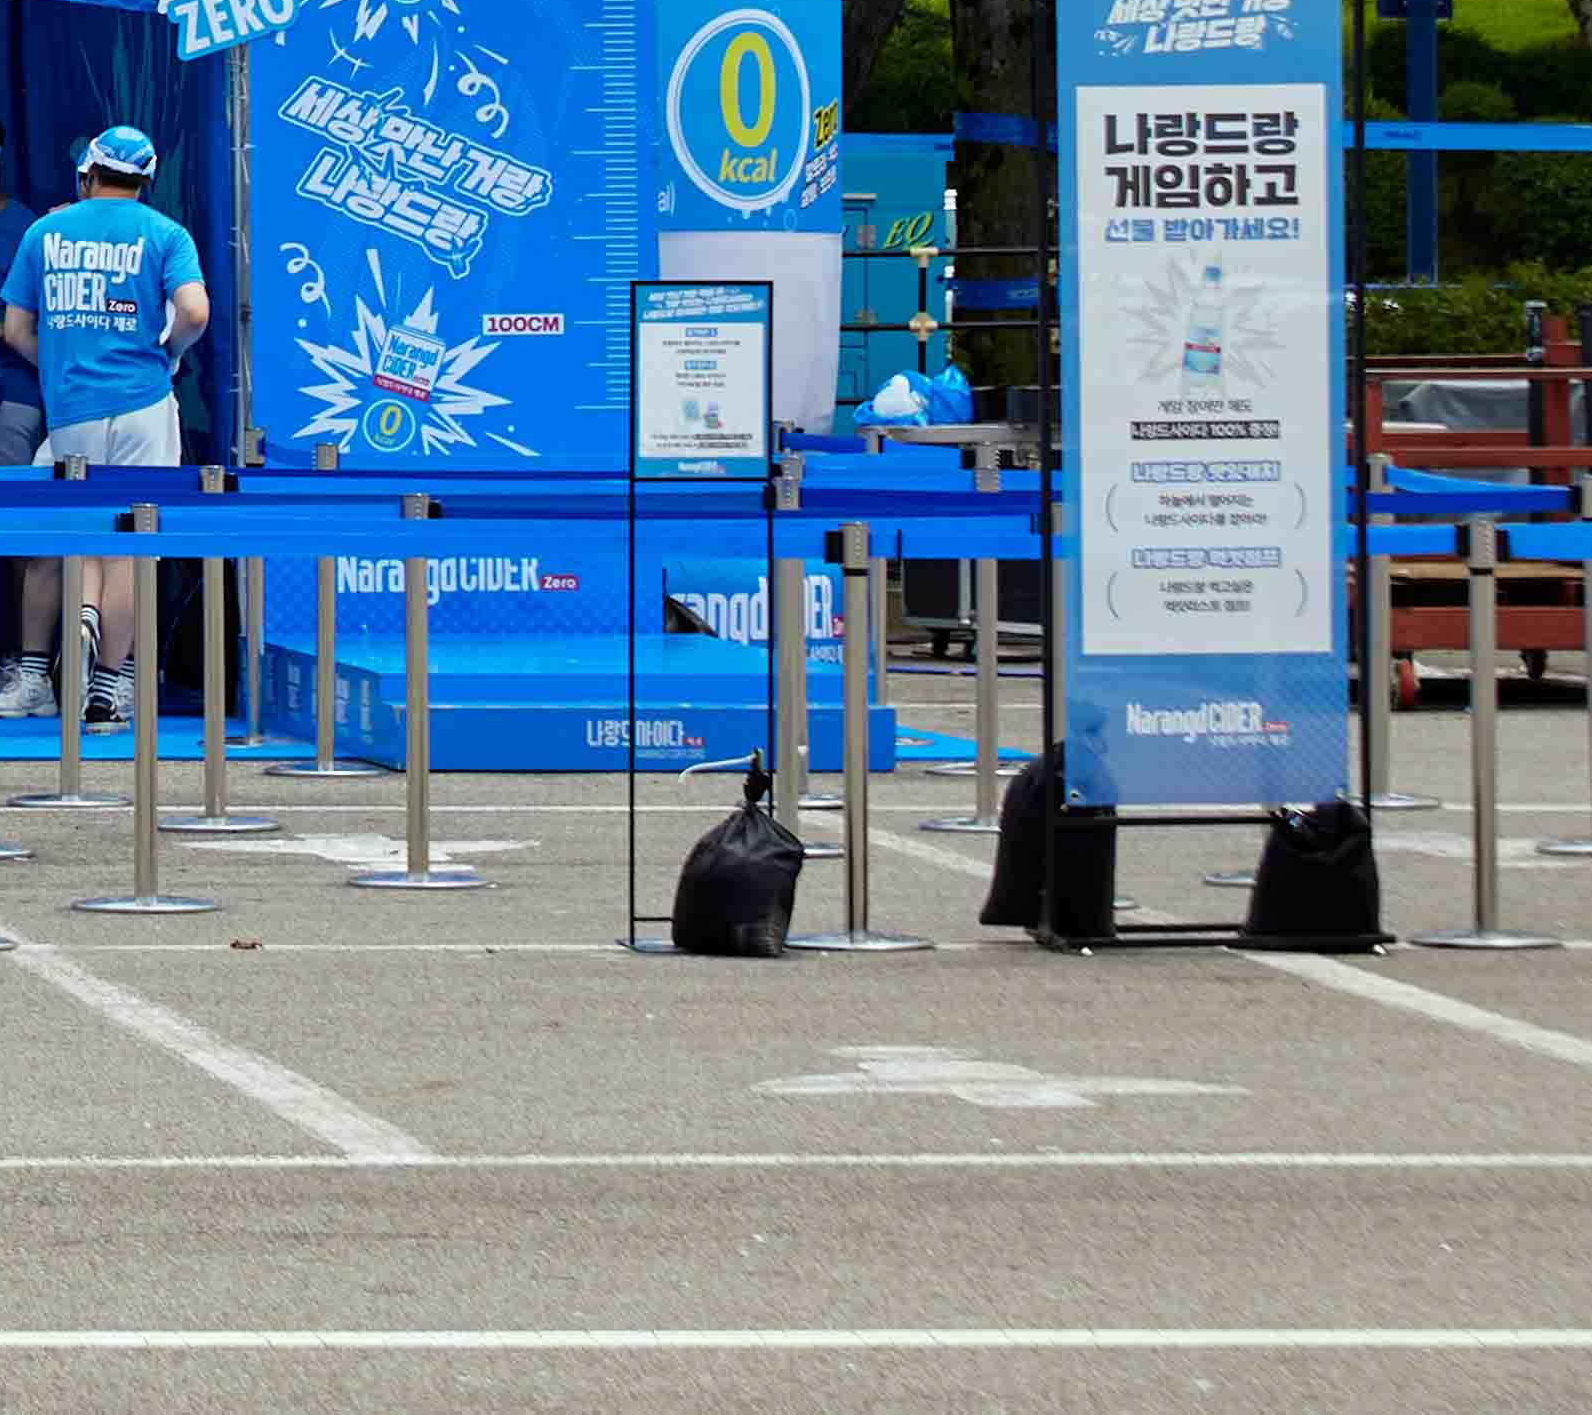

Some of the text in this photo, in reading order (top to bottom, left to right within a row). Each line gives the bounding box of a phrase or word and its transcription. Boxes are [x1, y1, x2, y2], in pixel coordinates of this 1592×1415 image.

[1143, 16, 1266, 54] 나랑드랑
[720, 32, 775, 147] 0
[288, 83, 380, 143] 세상
[1105, 110, 1299, 157] 나랑드랑
[719, 148, 777, 182] kcal
[306, 155, 480, 250] 나랑드랑
[1106, 164, 1299, 209] 게임하고
[1104, 217, 1300, 242] 선물 받아가세요!
[44, 232, 145, 284] Narangd
[108, 300, 136, 312] Zero
[114, 317, 137, 331] 제로
[486, 316, 560, 332] 100CM
[380, 405, 402, 435] 0
[543, 576, 576, 589] Zero
